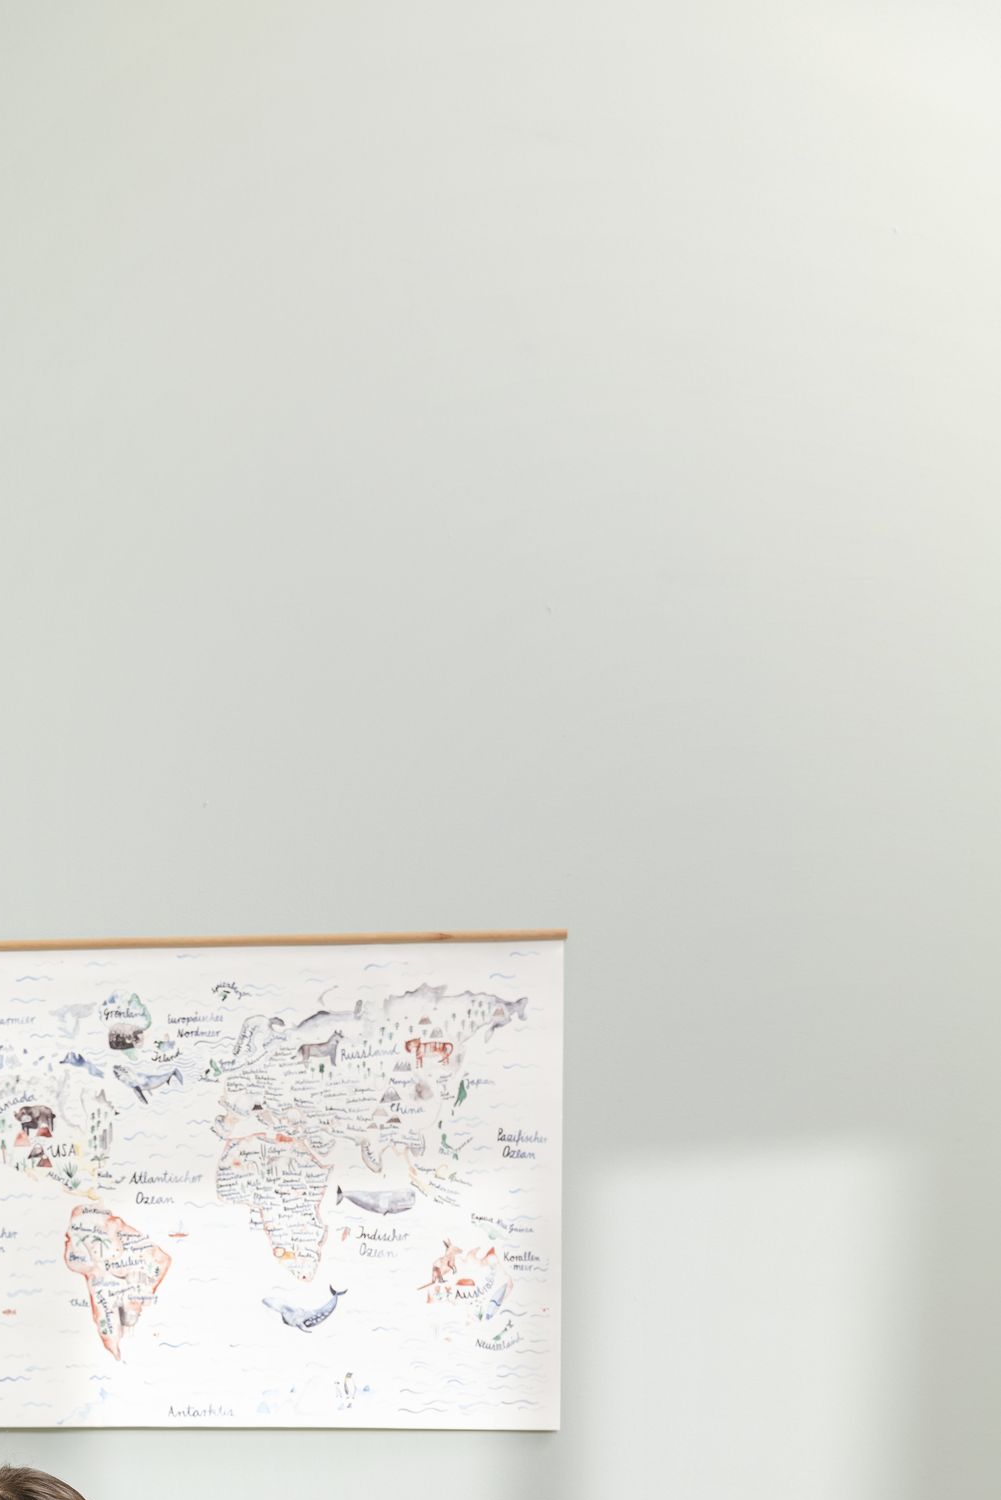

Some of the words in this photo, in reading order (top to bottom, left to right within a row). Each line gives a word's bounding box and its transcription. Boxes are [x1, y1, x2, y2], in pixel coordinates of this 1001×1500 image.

[341, 1043, 401, 1062] Russland
[390, 1102, 424, 1115] China
[497, 1128, 548, 1147] Pazifischer
[47, 1143, 76, 1159] USA
[502, 1145, 536, 1160] Ozean
[129, 1170, 203, 1185] Atlantischer
[136, 1191, 175, 1205] Ozean
[355, 1224, 410, 1242] Indischer
[360, 1242, 398, 1258] Ozean
[168, 1404, 234, 1419] Antarktis
